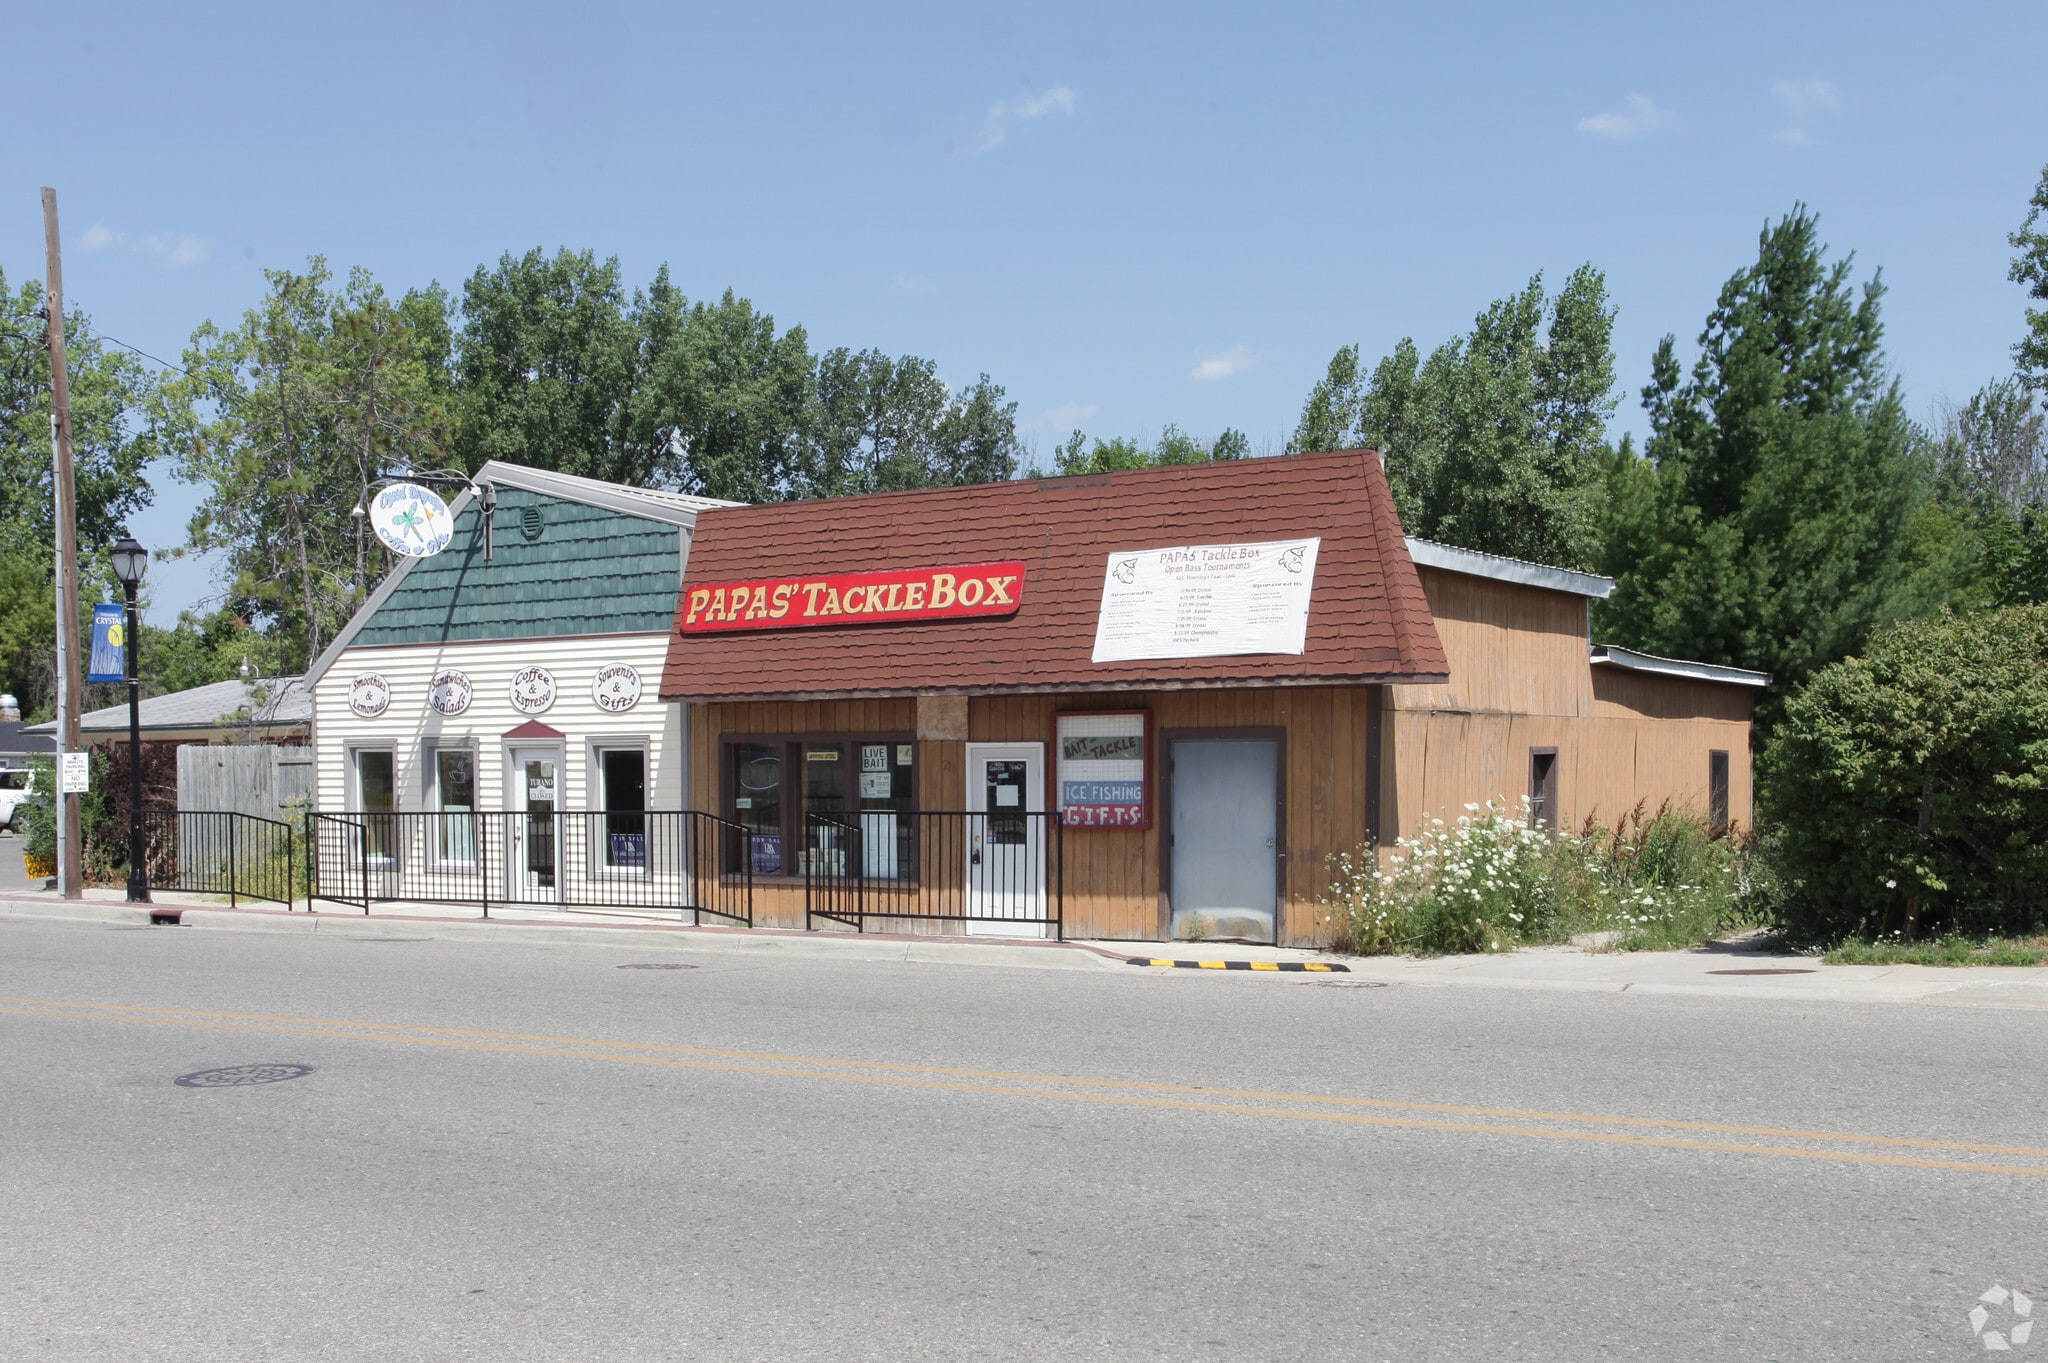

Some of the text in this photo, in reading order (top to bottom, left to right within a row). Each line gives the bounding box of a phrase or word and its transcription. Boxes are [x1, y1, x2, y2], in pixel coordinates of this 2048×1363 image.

[1202, 547, 1237, 560] Tackle
[1240, 548, 1260, 559] Box
[1165, 562, 1250, 574] Open Bass Tournaments
[928, 572, 1017, 608] BOX
[95, 617, 122, 625] CRYSTAL
[353, 675, 386, 692] Smoothies
[432, 672, 470, 694] Sandwiches
[515, 667, 549, 686] Coffee
[598, 667, 637, 688] Souvenirs
[445, 687, 453, 697] &
[528, 684, 537, 694] &
[612, 682, 621, 692] &
[365, 691, 373, 700] &
[434, 693, 465, 713] Salads
[515, 689, 551, 710] Espresso
[600, 694, 634, 710] Gifts
[353, 696, 386, 714] Lemonade
[864, 748, 885, 758] LIVE
[1090, 737, 1136, 759] TACKLE
[864, 758, 885, 768] BAIT
[1066, 785, 1141, 800] ICE FISHING
